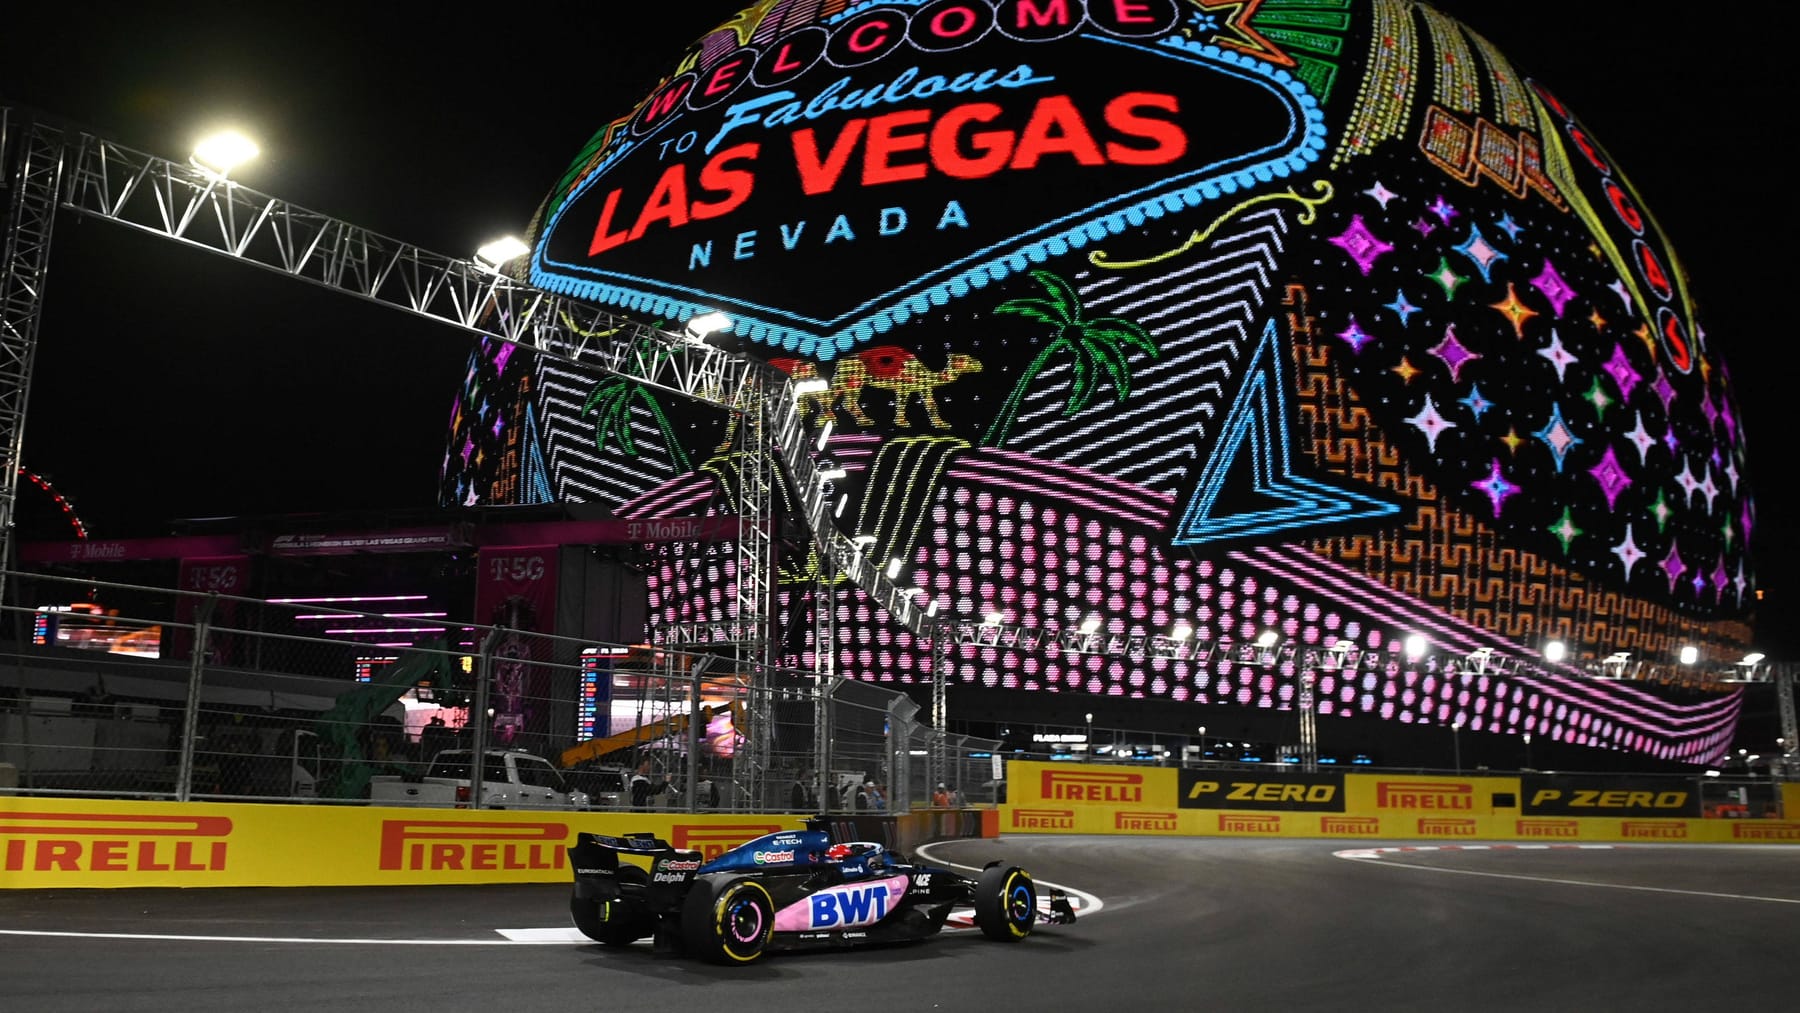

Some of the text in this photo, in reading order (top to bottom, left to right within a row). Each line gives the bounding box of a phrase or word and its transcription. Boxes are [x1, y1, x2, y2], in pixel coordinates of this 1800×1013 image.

[645, 0, 1155, 123] WELCOME
[705, 64, 1055, 154] Fabulous
[659, 131, 698, 160] TO
[587, 91, 1188, 257] LAS VEGAS
[688, 200, 968, 270] NEVADA
[1041, 770, 1144, 802] PIRELLI
[1188, 781, 1336, 802] P ZERO
[1377, 782, 1473, 810] PIRELLI
[1531, 789, 1688, 808] P ZERO
[1012, 809, 1074, 829] PIRELLI
[1115, 812, 1178, 830] PIRELLI
[1219, 814, 1280, 832] PIRELLI
[1321, 816, 1379, 834] PIRELLI
[1418, 818, 1476, 835] PIRELLI
[1516, 820, 1578, 837] PIRELLI
[1622, 822, 1687, 838] PIRELLI
[379, 820, 569, 870] PIRELLI
[764, 850, 794, 862] Castrol
[653, 872, 686, 884] Delphi
[811, 886, 888, 928] BWT
